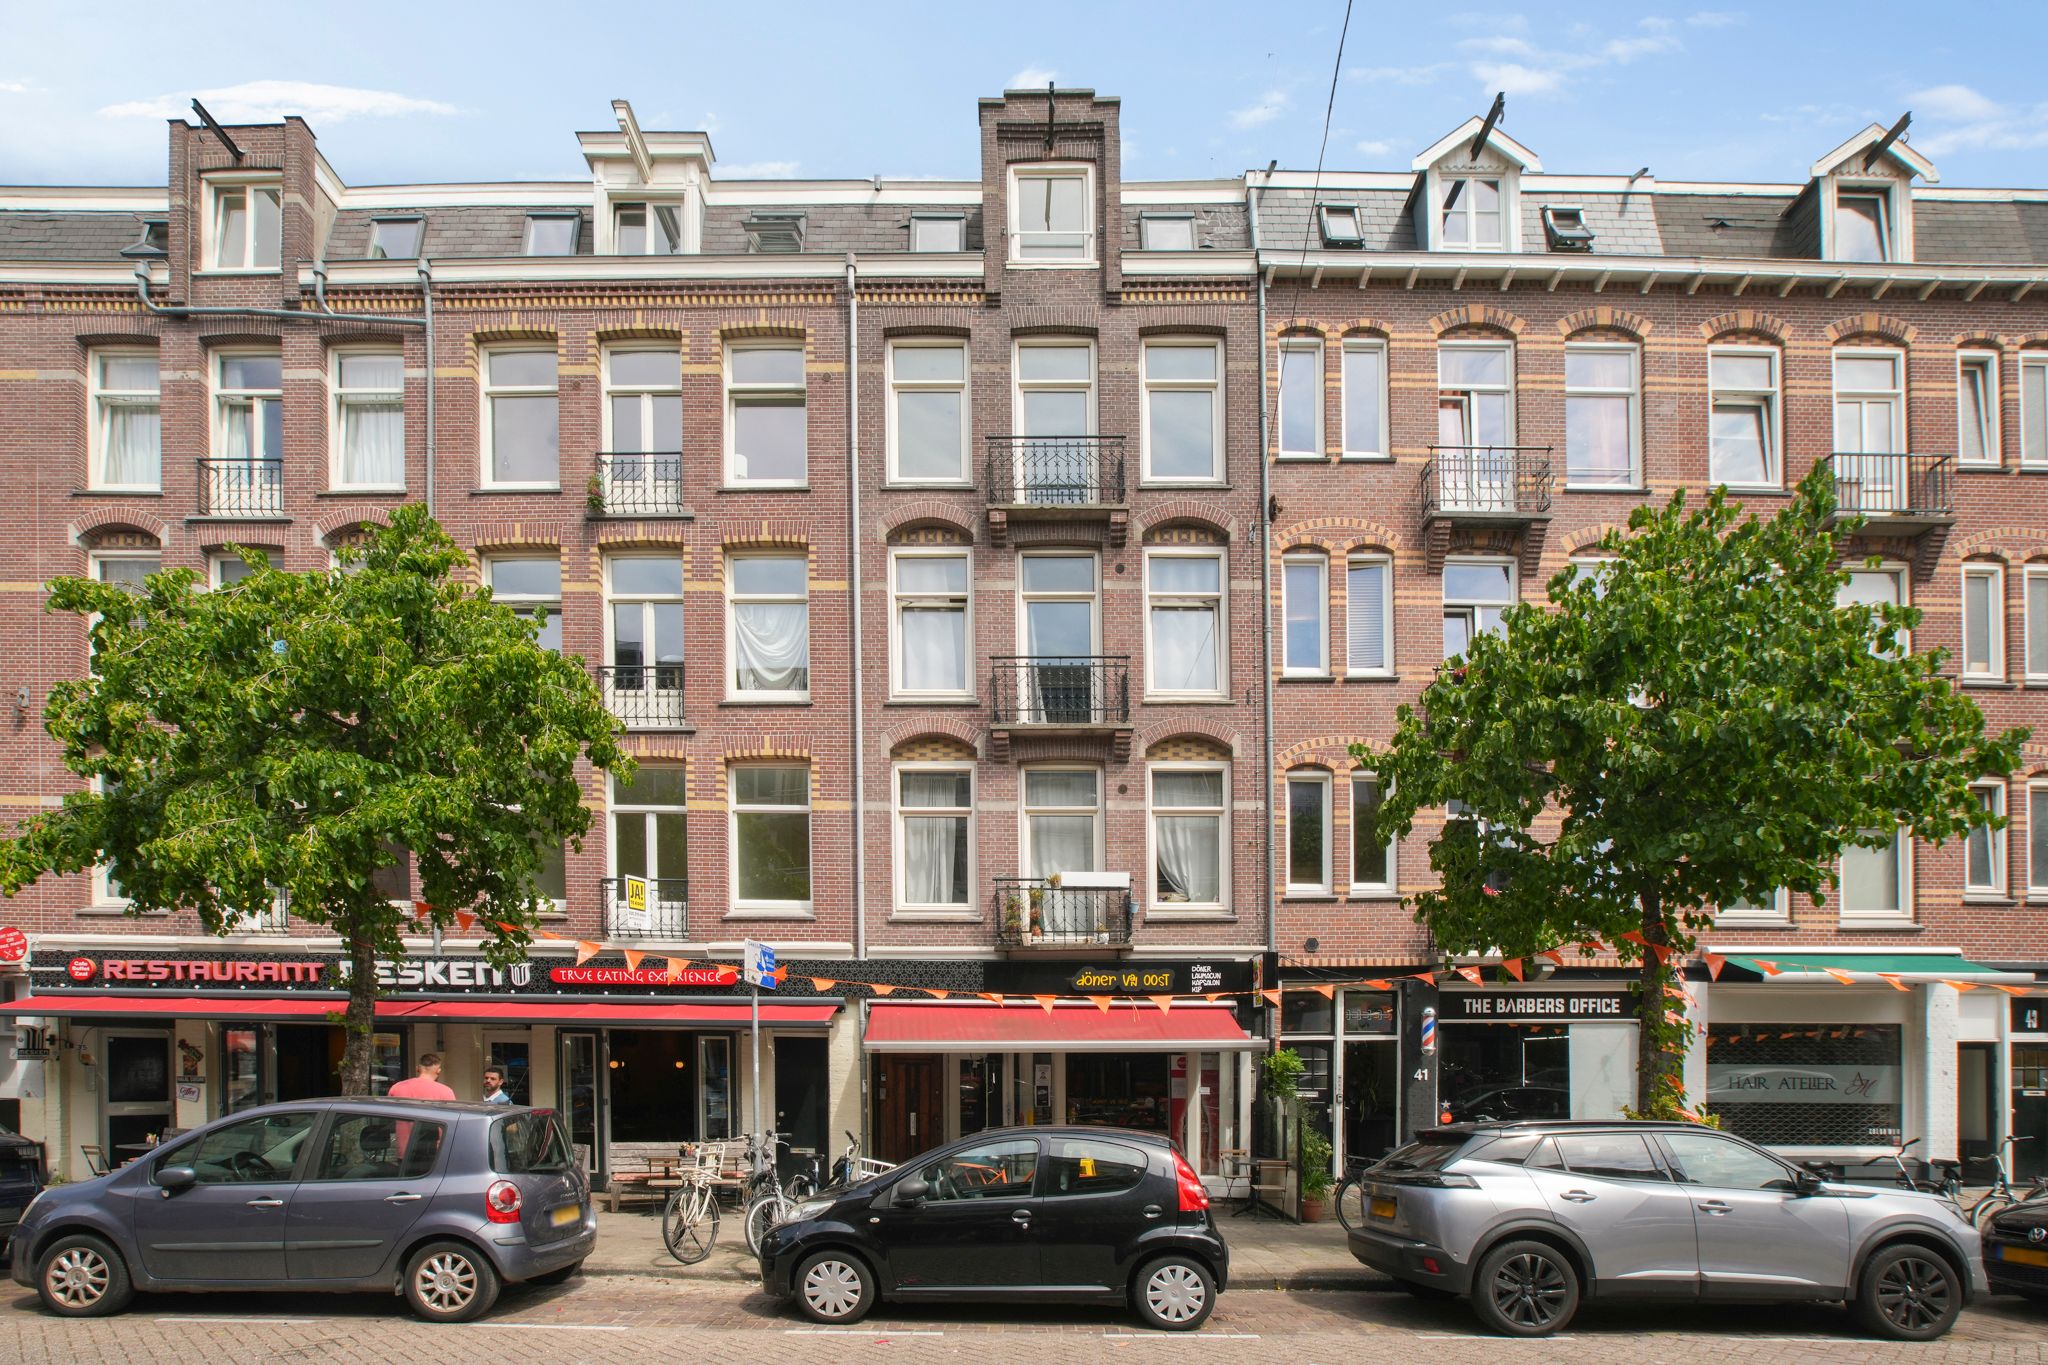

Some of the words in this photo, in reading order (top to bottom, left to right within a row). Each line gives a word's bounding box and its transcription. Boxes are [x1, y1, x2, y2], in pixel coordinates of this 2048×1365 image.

[630, 883, 644, 901] JA!
[103, 959, 324, 982] RESTAURANT
[559, 969, 592, 981] TRUE
[596, 970, 644, 983] EATING
[648, 969, 721, 983] EXPRIENCE
[1191, 964, 1212, 973] DÖNER
[1076, 971, 1117, 987] döner
[1463, 998, 1492, 1014] THE
[1496, 998, 1565, 1014] BARBERS
[1569, 998, 1621, 1014] OFFICE
[1413, 1068, 1429, 1081] 41
[1728, 1076, 1769, 1090] HAIR
[1777, 1077, 1837, 1091] ATELIER
